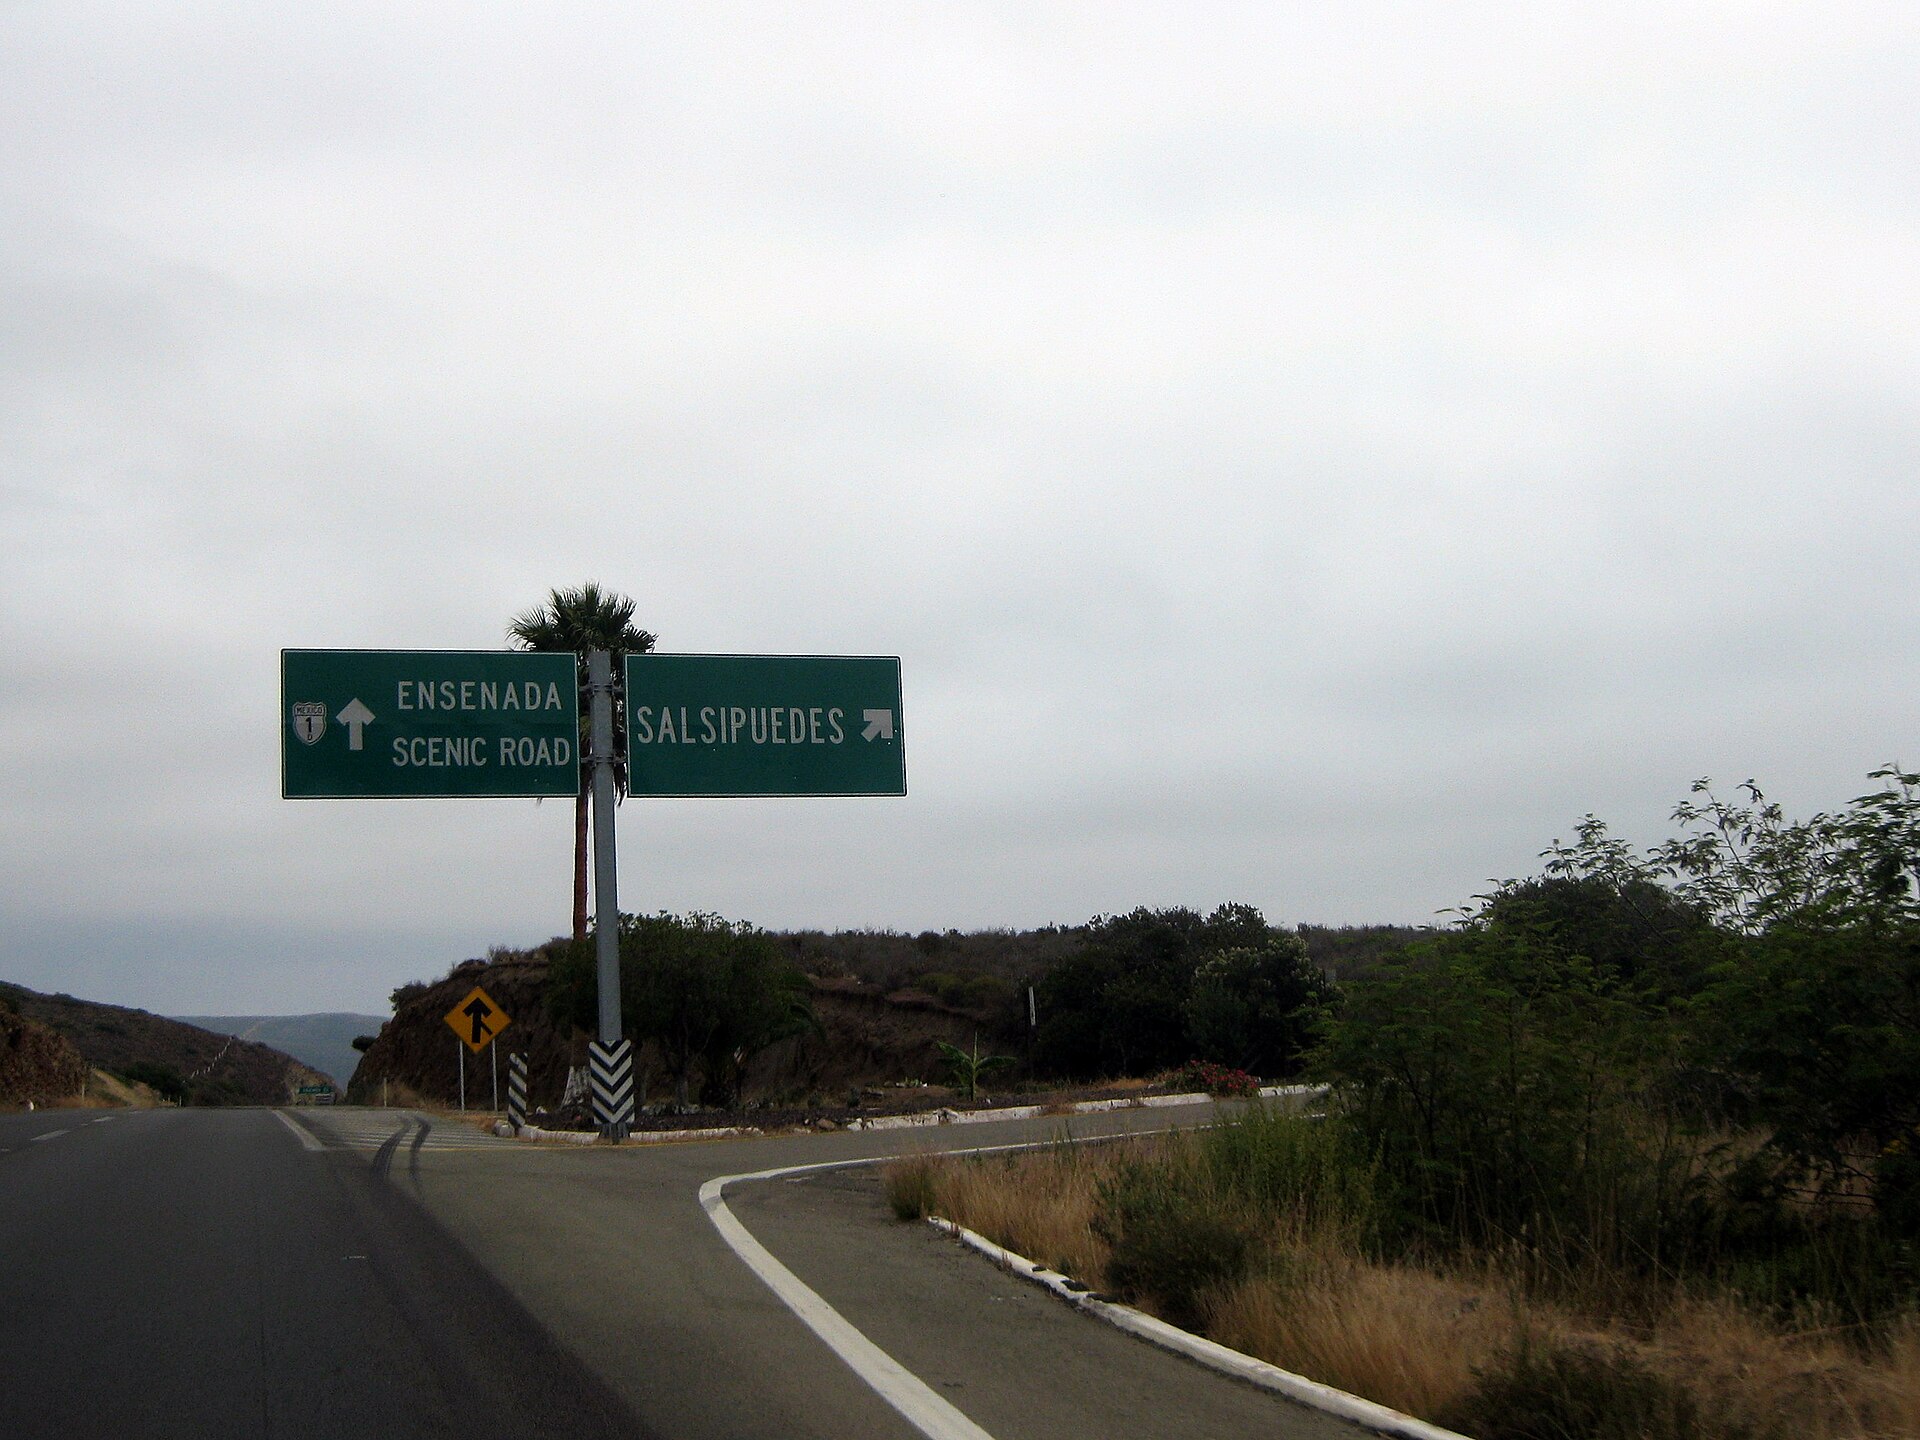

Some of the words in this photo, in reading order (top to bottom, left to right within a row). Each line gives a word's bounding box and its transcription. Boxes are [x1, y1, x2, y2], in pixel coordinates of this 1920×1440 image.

[397, 681, 563, 711] ENSENADA
[305, 717, 312, 732] 1
[636, 706, 845, 744] SALSIPUEDES
[393, 737, 487, 767] SCENIC
[501, 738, 571, 767] ROAD
